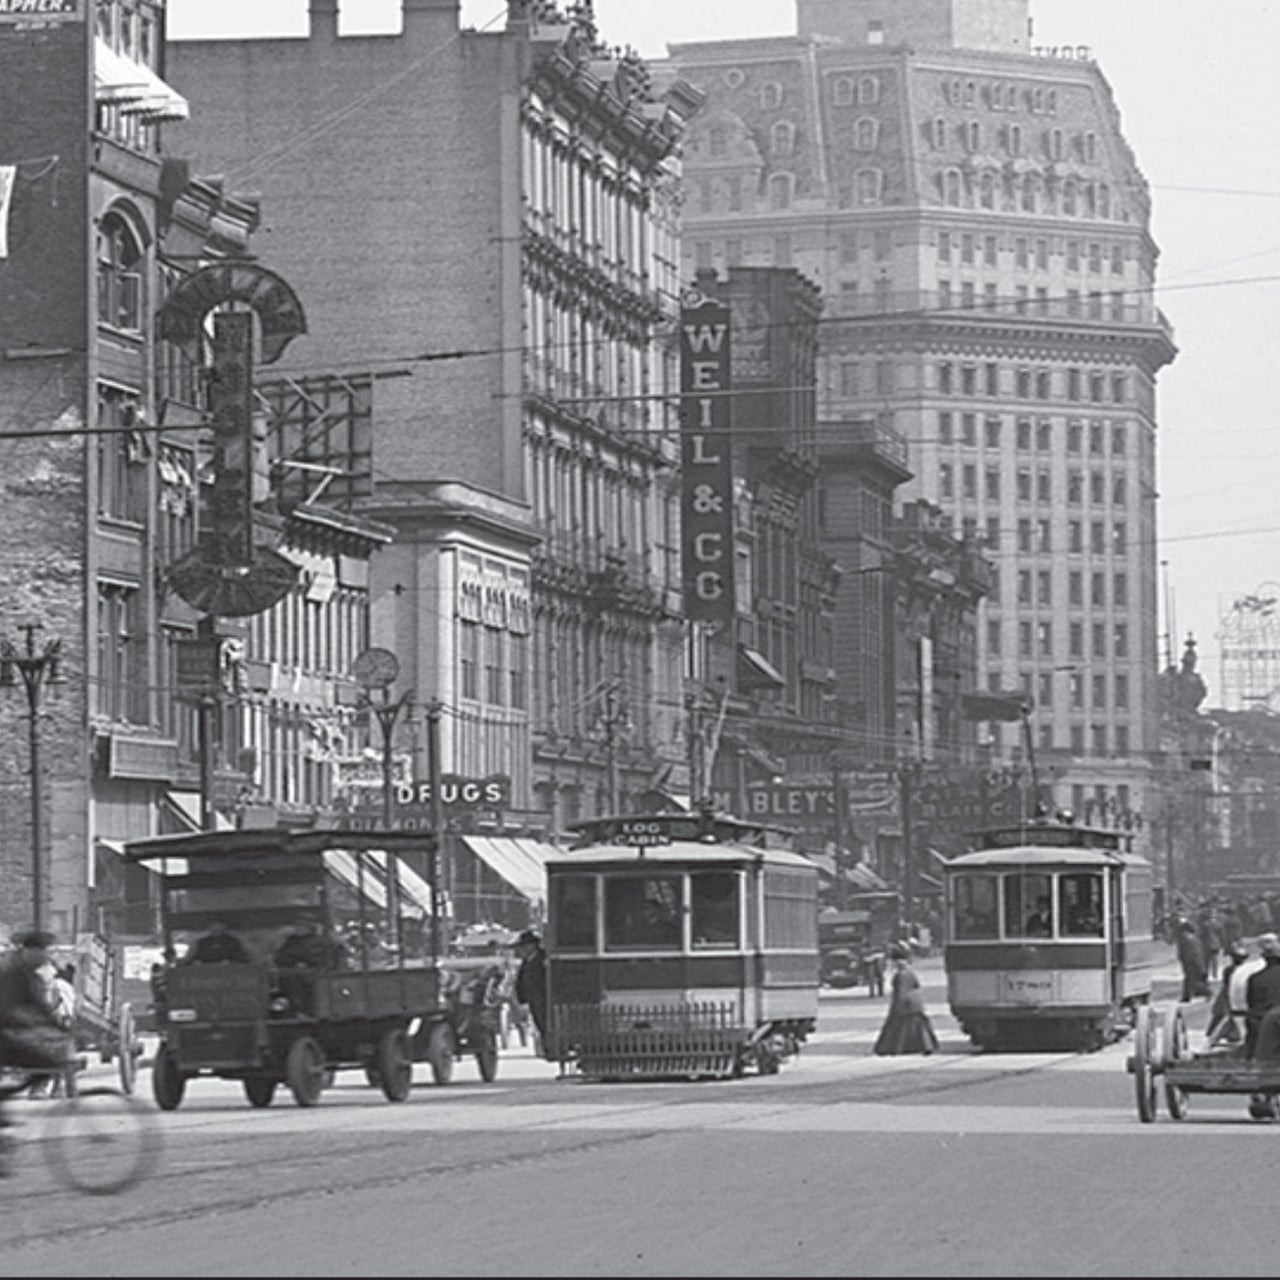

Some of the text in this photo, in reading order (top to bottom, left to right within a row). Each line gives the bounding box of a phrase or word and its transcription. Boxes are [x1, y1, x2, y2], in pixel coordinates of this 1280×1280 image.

[684, 324, 726, 463] WEIL
[693, 485, 722, 513] &
[622, 823, 660, 834] LOG
